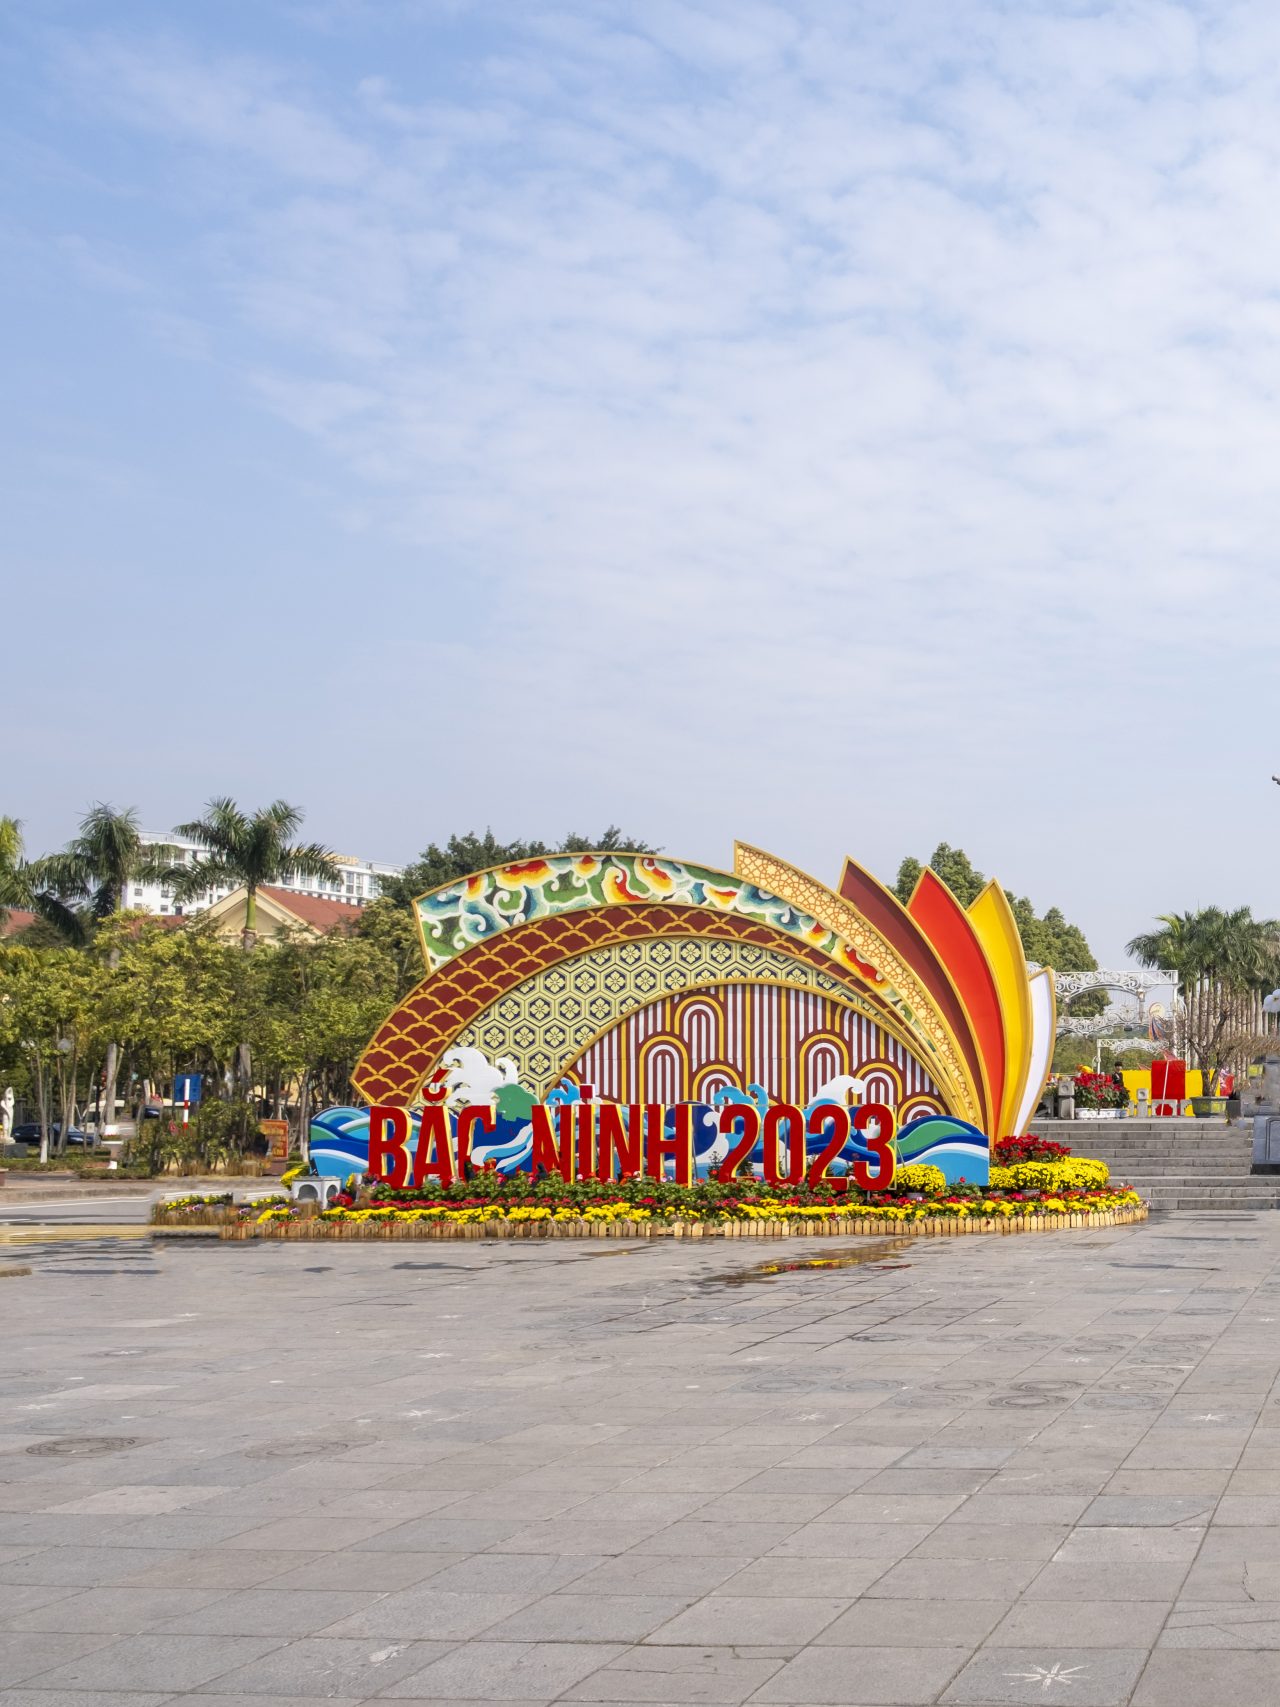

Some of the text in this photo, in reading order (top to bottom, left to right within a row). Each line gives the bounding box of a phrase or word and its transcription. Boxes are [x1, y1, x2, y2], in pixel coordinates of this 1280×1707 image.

[367, 1068, 897, 1190] BẮC NINH 2023
